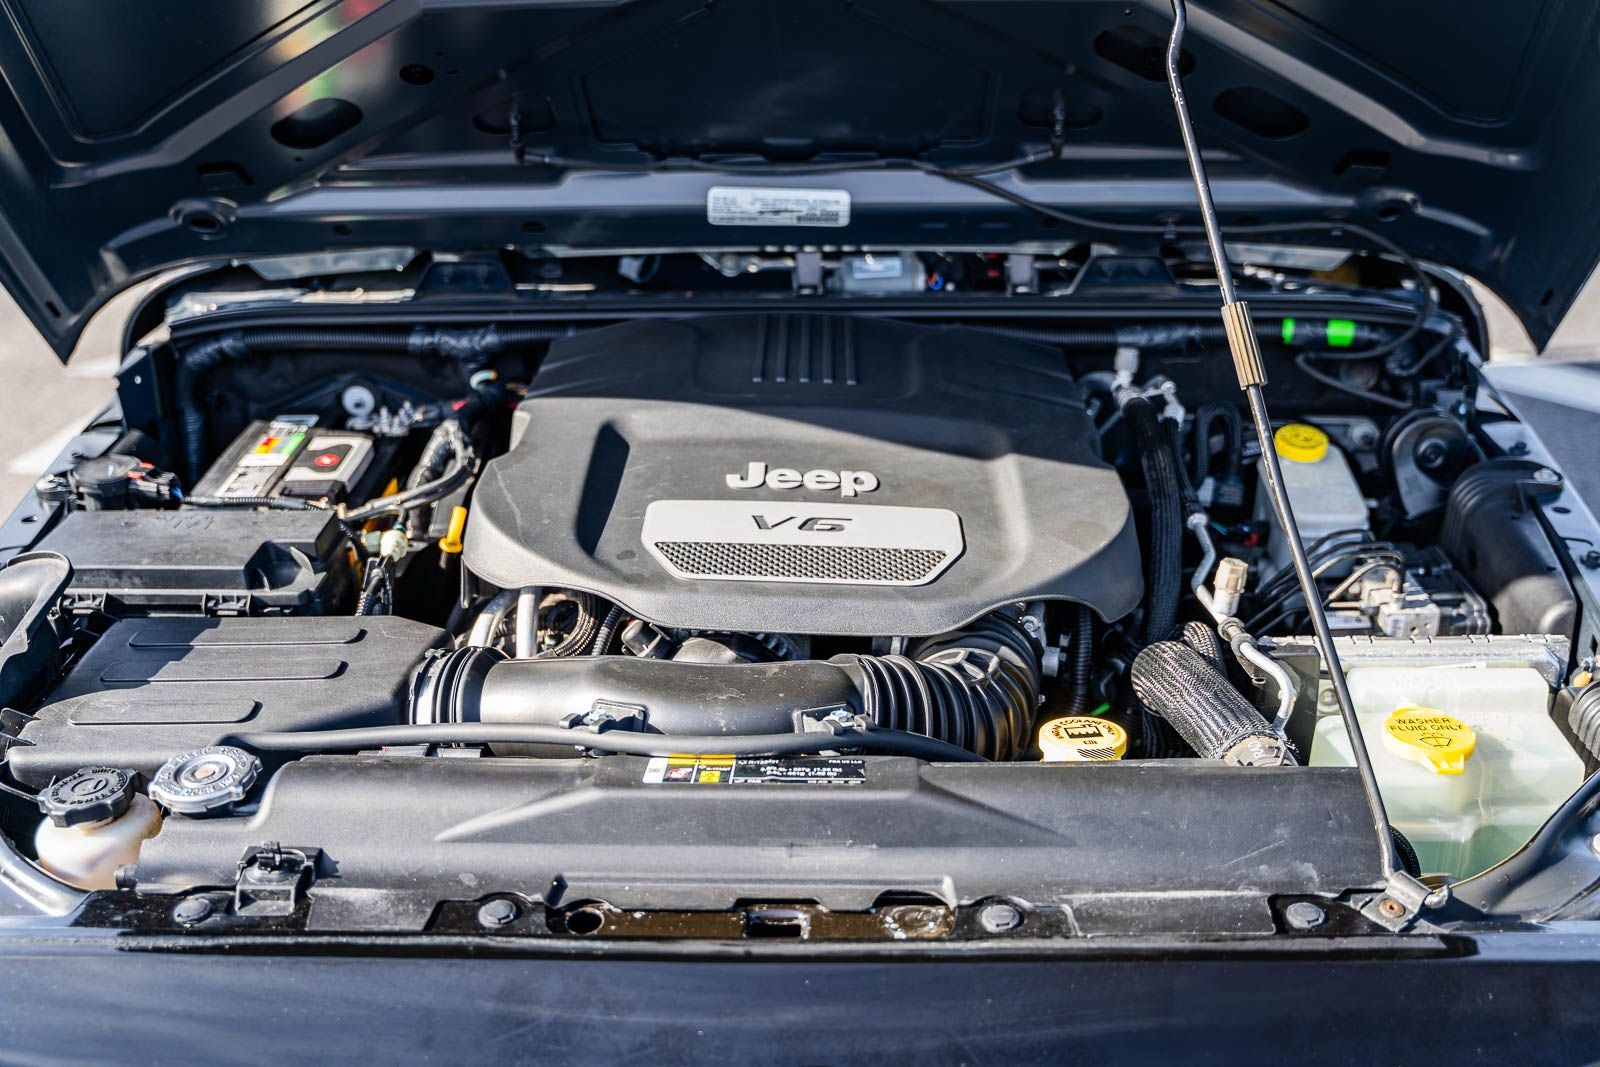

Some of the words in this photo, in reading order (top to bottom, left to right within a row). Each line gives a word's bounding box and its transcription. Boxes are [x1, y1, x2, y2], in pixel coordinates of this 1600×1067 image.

[725, 461, 879, 498] Jeep
[752, 514, 853, 532] V6
[1395, 717, 1451, 725] WASHER
[1430, 724, 1463, 732] ONLY
